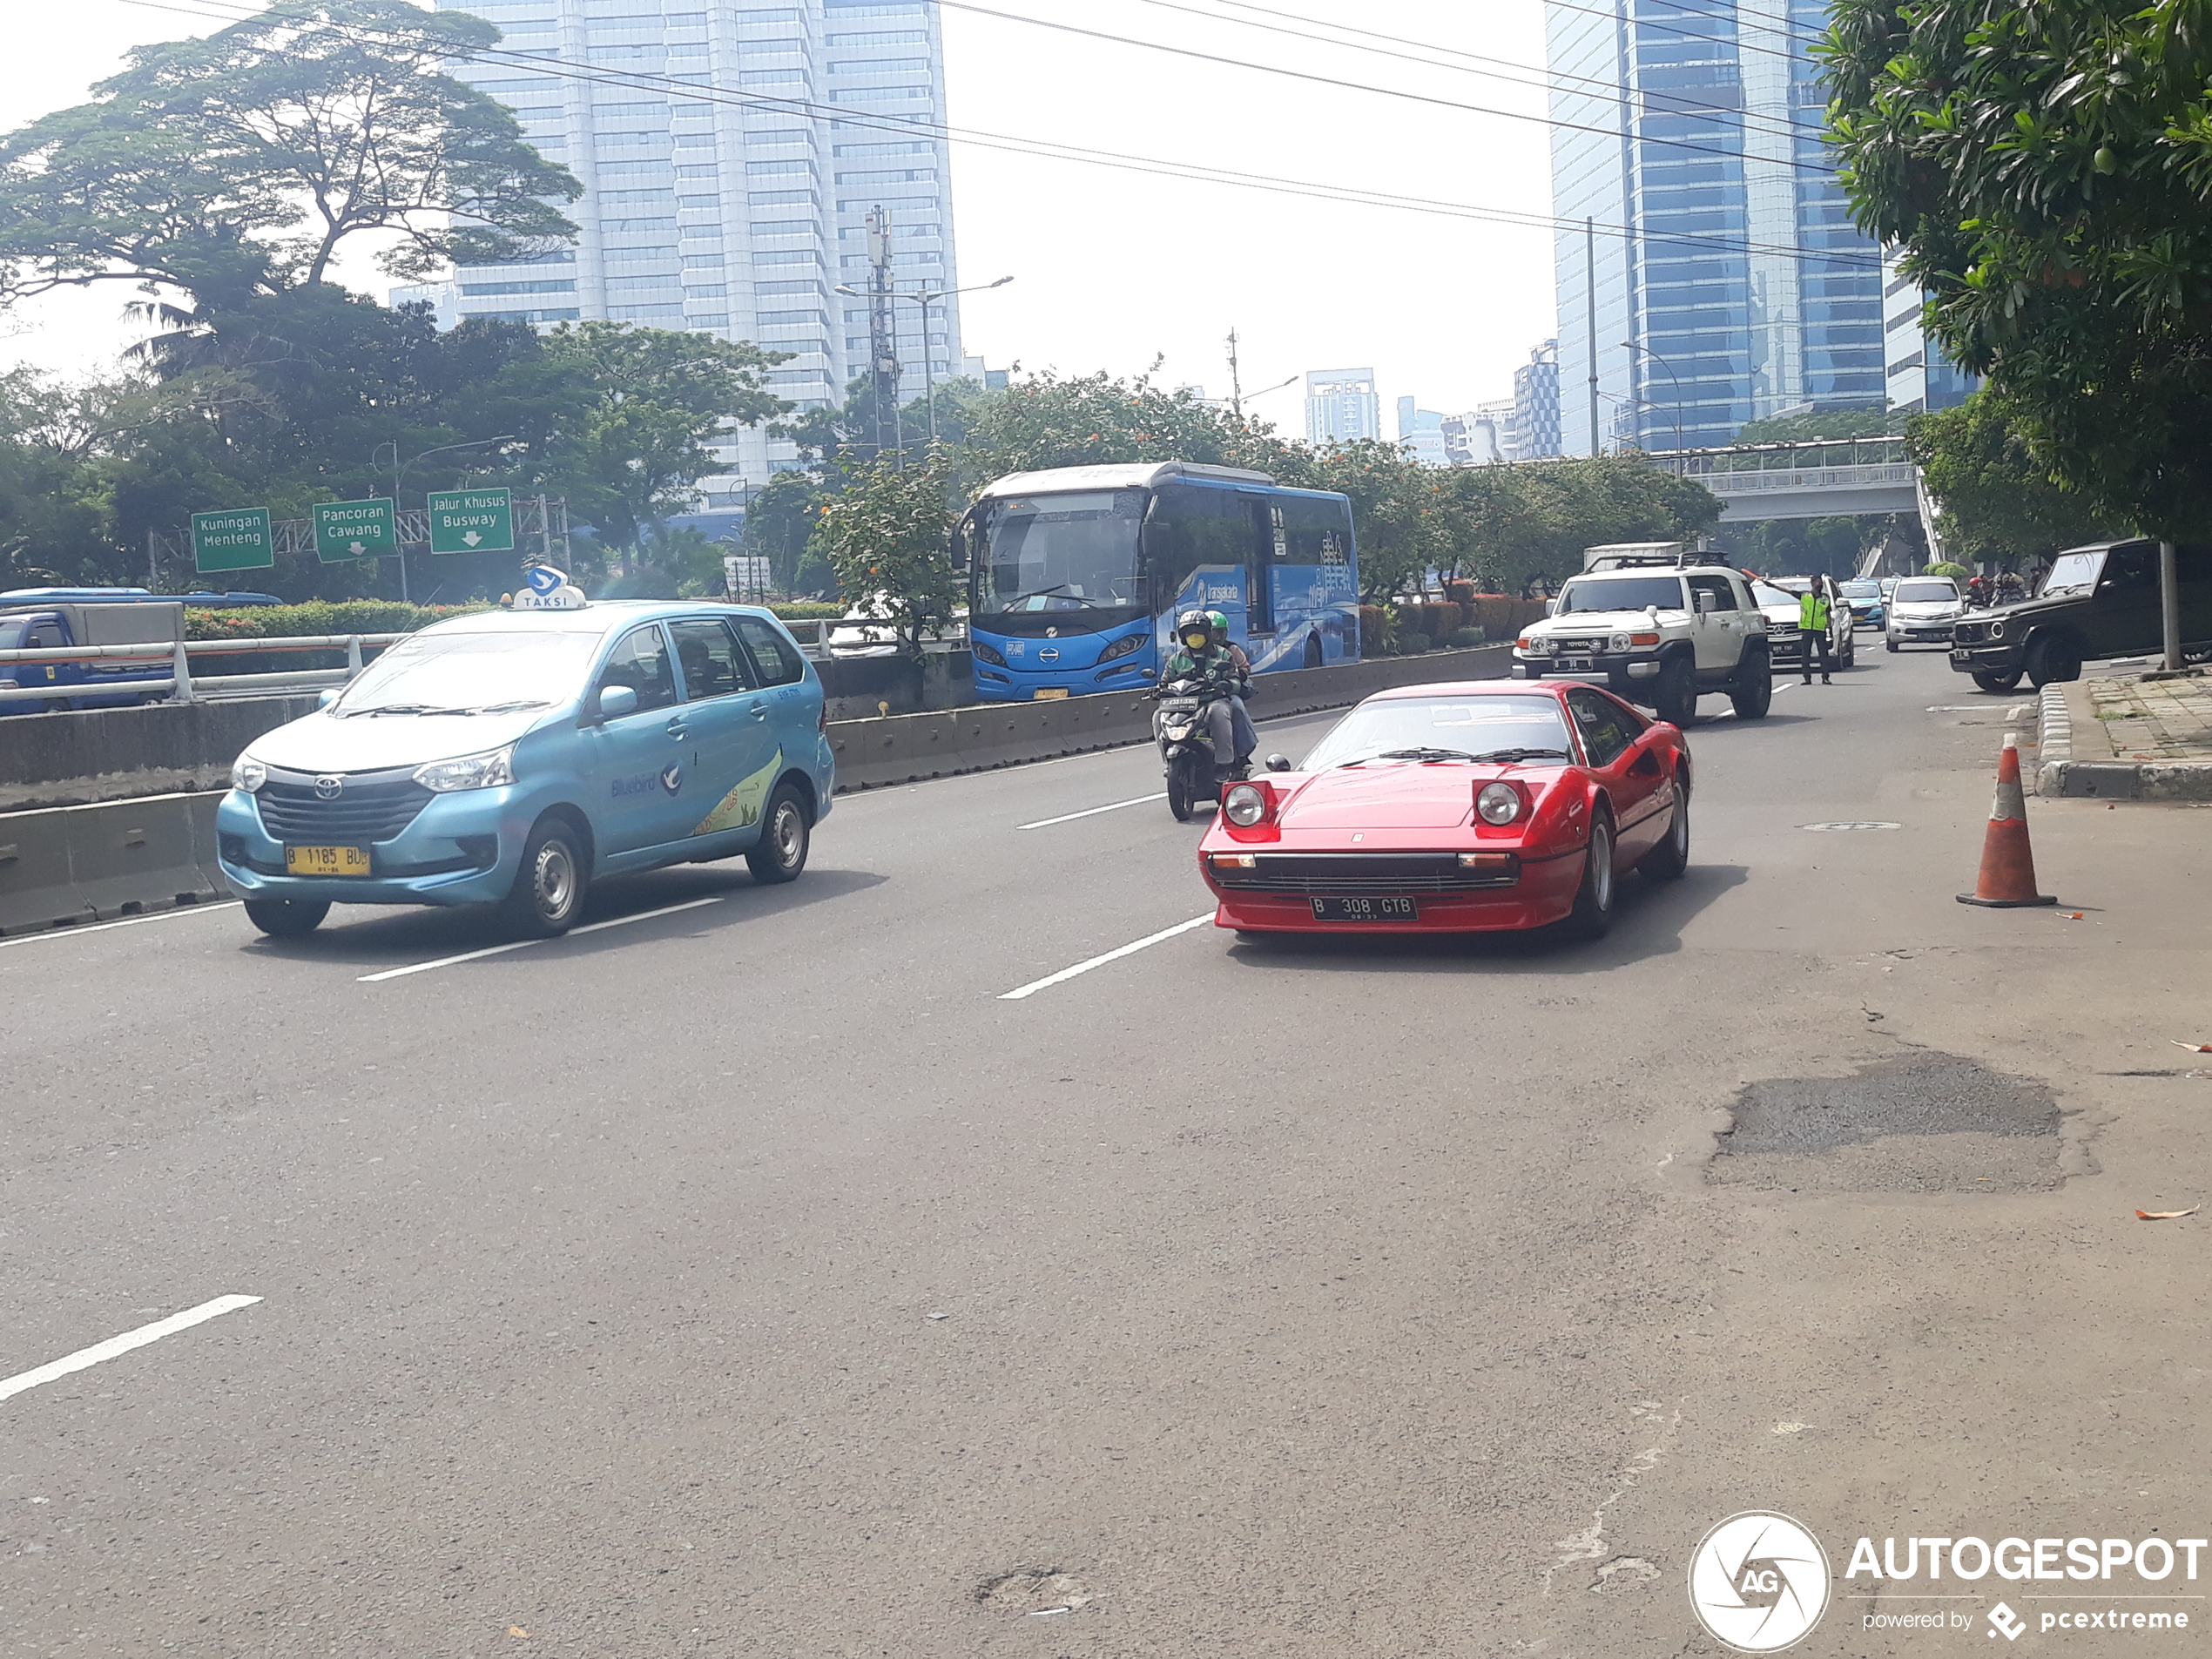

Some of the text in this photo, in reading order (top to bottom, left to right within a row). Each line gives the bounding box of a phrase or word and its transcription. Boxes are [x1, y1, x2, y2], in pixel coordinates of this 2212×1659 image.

[434, 496, 505, 511] Jalur Khusus
[322, 507, 384, 522] Pancoran
[443, 514, 496, 528] Busway
[200, 516, 260, 531] Kuningan
[327, 524, 381, 537] Cawang
[204, 532, 260, 547] Menteng
[524, 597, 567, 607] TAKSI
[611, 773, 655, 798] Bluebird
[287, 848, 296, 865] B
[307, 848, 337, 865] 1185
[1313, 898, 1411, 914] B 308 GTB
